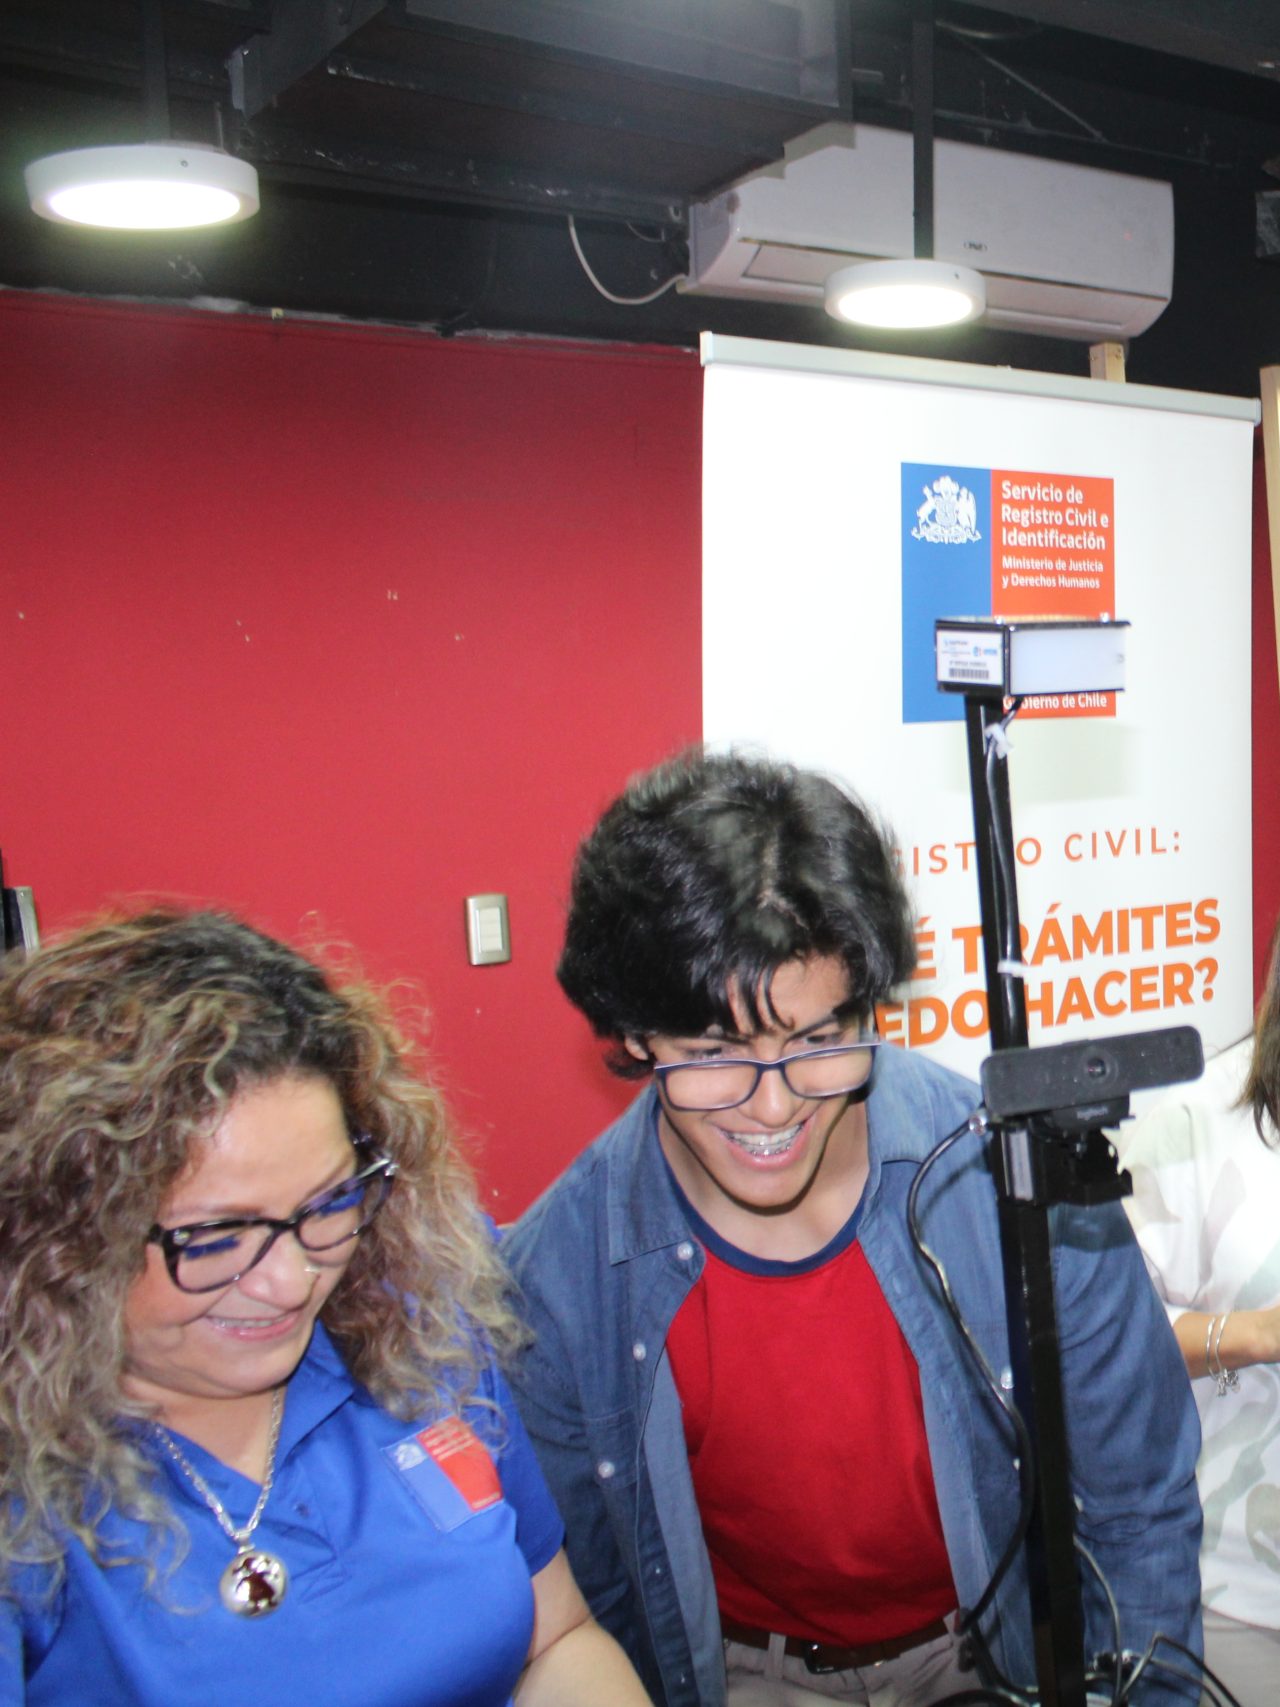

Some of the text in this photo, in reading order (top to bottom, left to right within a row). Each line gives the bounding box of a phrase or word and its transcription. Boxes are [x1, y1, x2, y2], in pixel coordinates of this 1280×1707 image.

[1002, 480, 1083, 504] Servicio de
[1001, 503, 1109, 528] Registro Civil e
[1002, 526, 1106, 550] Identificación
[1002, 555, 1104, 572] Ministerio de Justicia
[1002, 573, 1100, 589] y Derechos Humanos
[1062, 693, 1076, 708] de
[1078, 692, 1107, 708] Chile
[1064, 827, 1181, 862] CIVIL:
[1024, 957, 1219, 1029] HACER?
